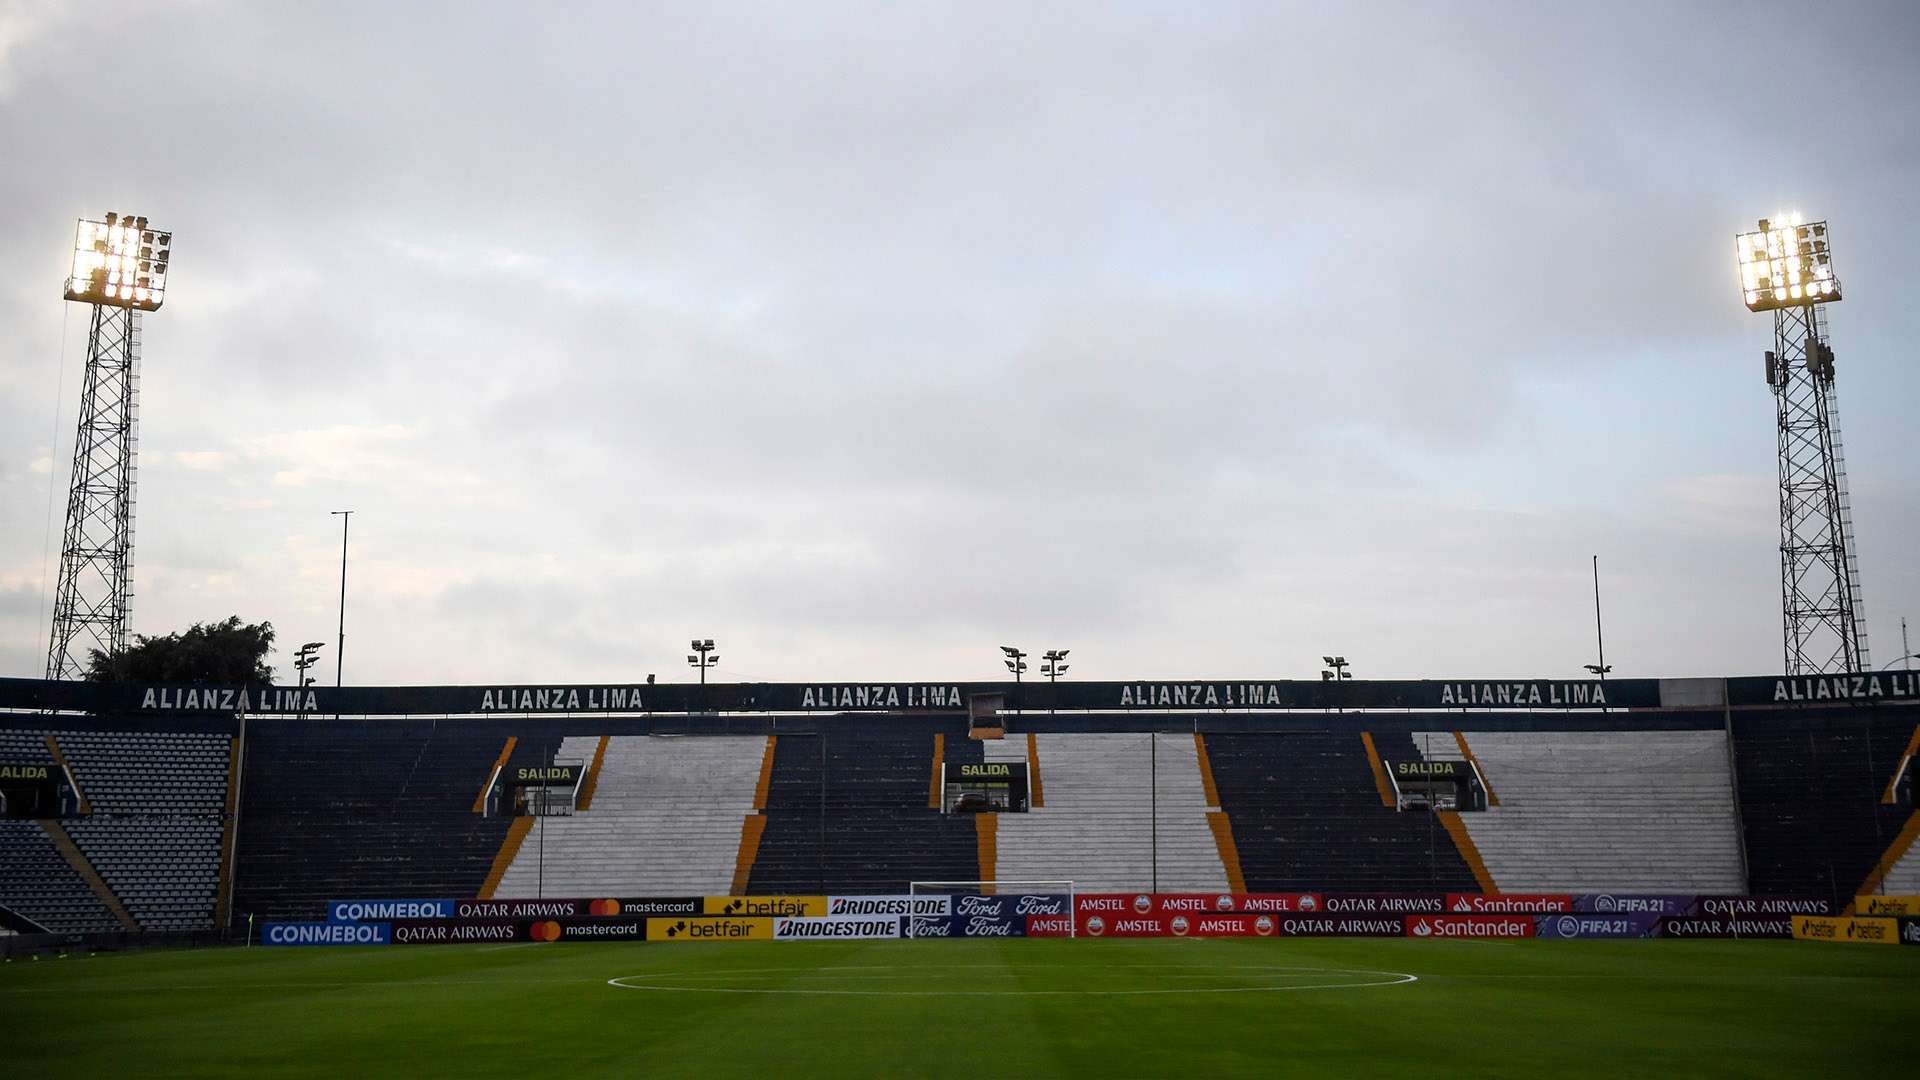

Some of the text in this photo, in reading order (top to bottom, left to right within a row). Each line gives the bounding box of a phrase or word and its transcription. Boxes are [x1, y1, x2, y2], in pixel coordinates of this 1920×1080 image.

[1120, 684, 1281, 706] ALIANZA LIMA
[1441, 683, 1606, 705] ALIANZA LIMA
[1774, 674, 1920, 701] ALIANZA LI
[141, 687, 318, 711] ALIANZA LIMA
[481, 688, 643, 710] ALIANZA LIMA
[802, 686, 962, 707] ALIANZA LIMA
[518, 767, 571, 779] SALIDA
[961, 764, 1010, 776] SALIDA
[1399, 762, 1454, 774] SALIDA
[335, 903, 446, 920] CONMEBOL
[459, 903, 574, 917] QATAR AIRWAYS
[625, 901, 694, 913] mastercard
[746, 899, 809, 915] betfair
[832, 899, 946, 914] BRIDGESTONE
[957, 896, 1002, 915] Ford
[1015, 895, 1061, 915] Ford
[1080, 899, 1125, 910] AMSTEL
[1162, 899, 1207, 910] AMSTEL
[1244, 899, 1289, 910] AMSTEL
[1327, 898, 1442, 912] QATAR AIRWAYS
[1474, 898, 1564, 913] Santander
[1617, 899, 1648, 912] FIFA
[1650, 899, 1664, 912] 21
[1703, 900, 1829, 915] QATAR AIRWAYS
[566, 923, 637, 935] mastercard
[690, 920, 754, 937] betfair
[777, 920, 896, 936] BRIDGESTONE
[905, 916, 950, 936] Ford
[965, 916, 1011, 936] Ford
[1115, 920, 1161, 931] AMSTEL
[1199, 920, 1245, 931] AMSTEL
[1284, 919, 1401, 934] QATAR AIRWAYS
[1434, 919, 1526, 936] Santander
[1580, 920, 1611, 933] FIFA
[1613, 920, 1628, 933] 21
[1668, 920, 1792, 935] QATAR AIRWAYS
[270, 926, 383, 942] CONMEBOL
[396, 926, 514, 943] QATAR AIRWAYS
